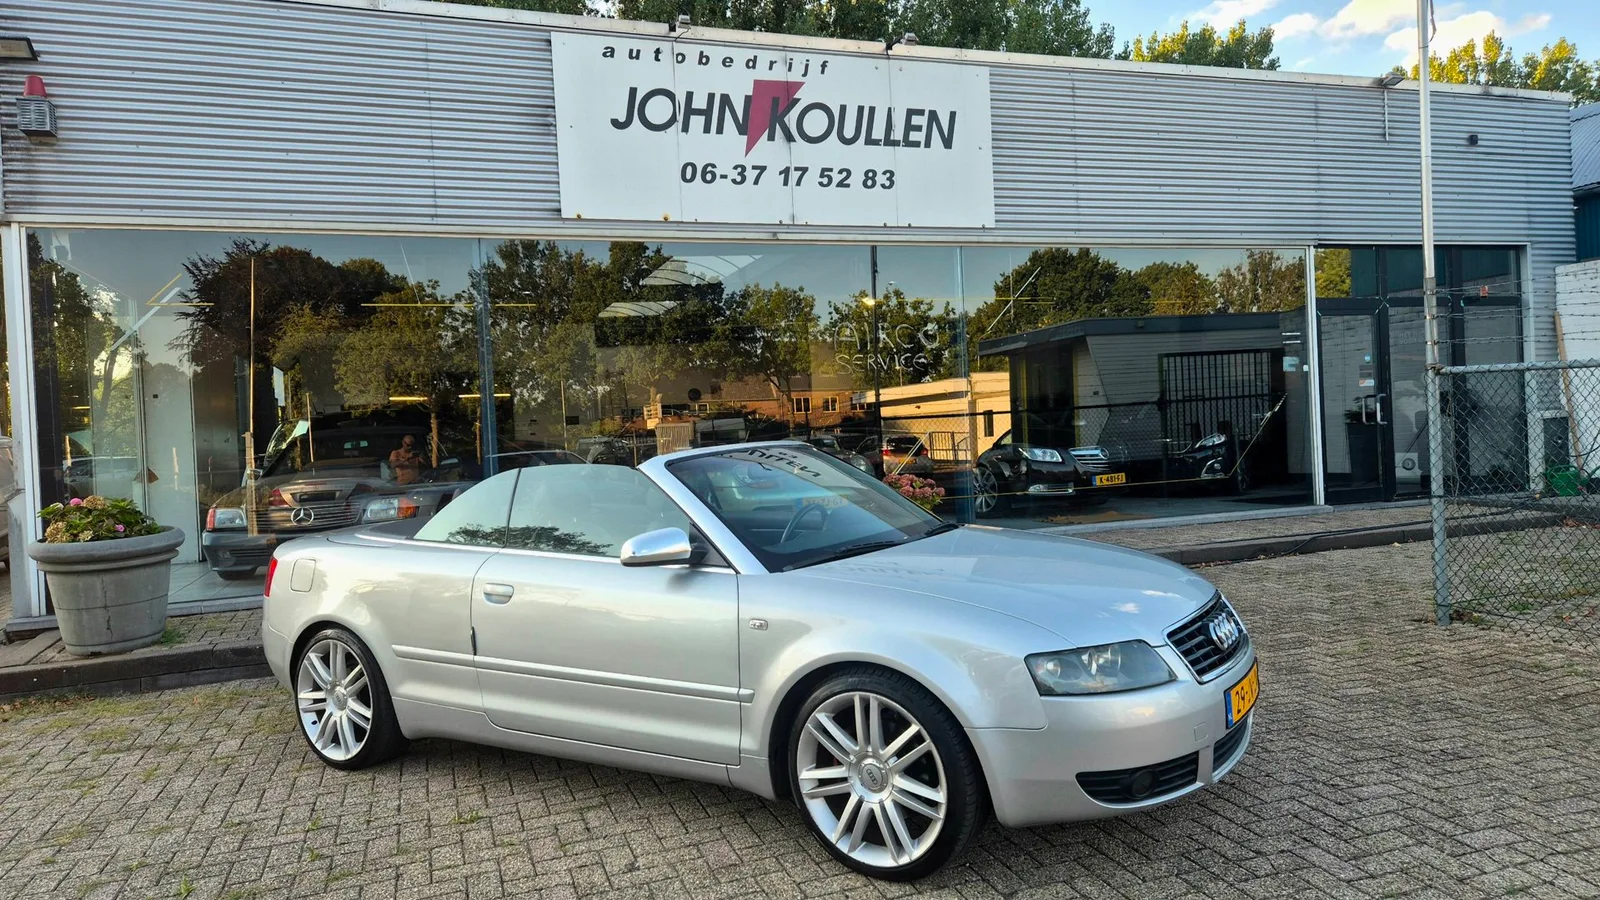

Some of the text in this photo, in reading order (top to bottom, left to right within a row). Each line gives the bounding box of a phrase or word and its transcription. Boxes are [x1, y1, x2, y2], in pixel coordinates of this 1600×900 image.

[602, 45, 829, 77] autobedrijf
[610, 86, 957, 149] JOHN KOULLEN
[680, 162, 895, 190] 06-37 17 52 83
